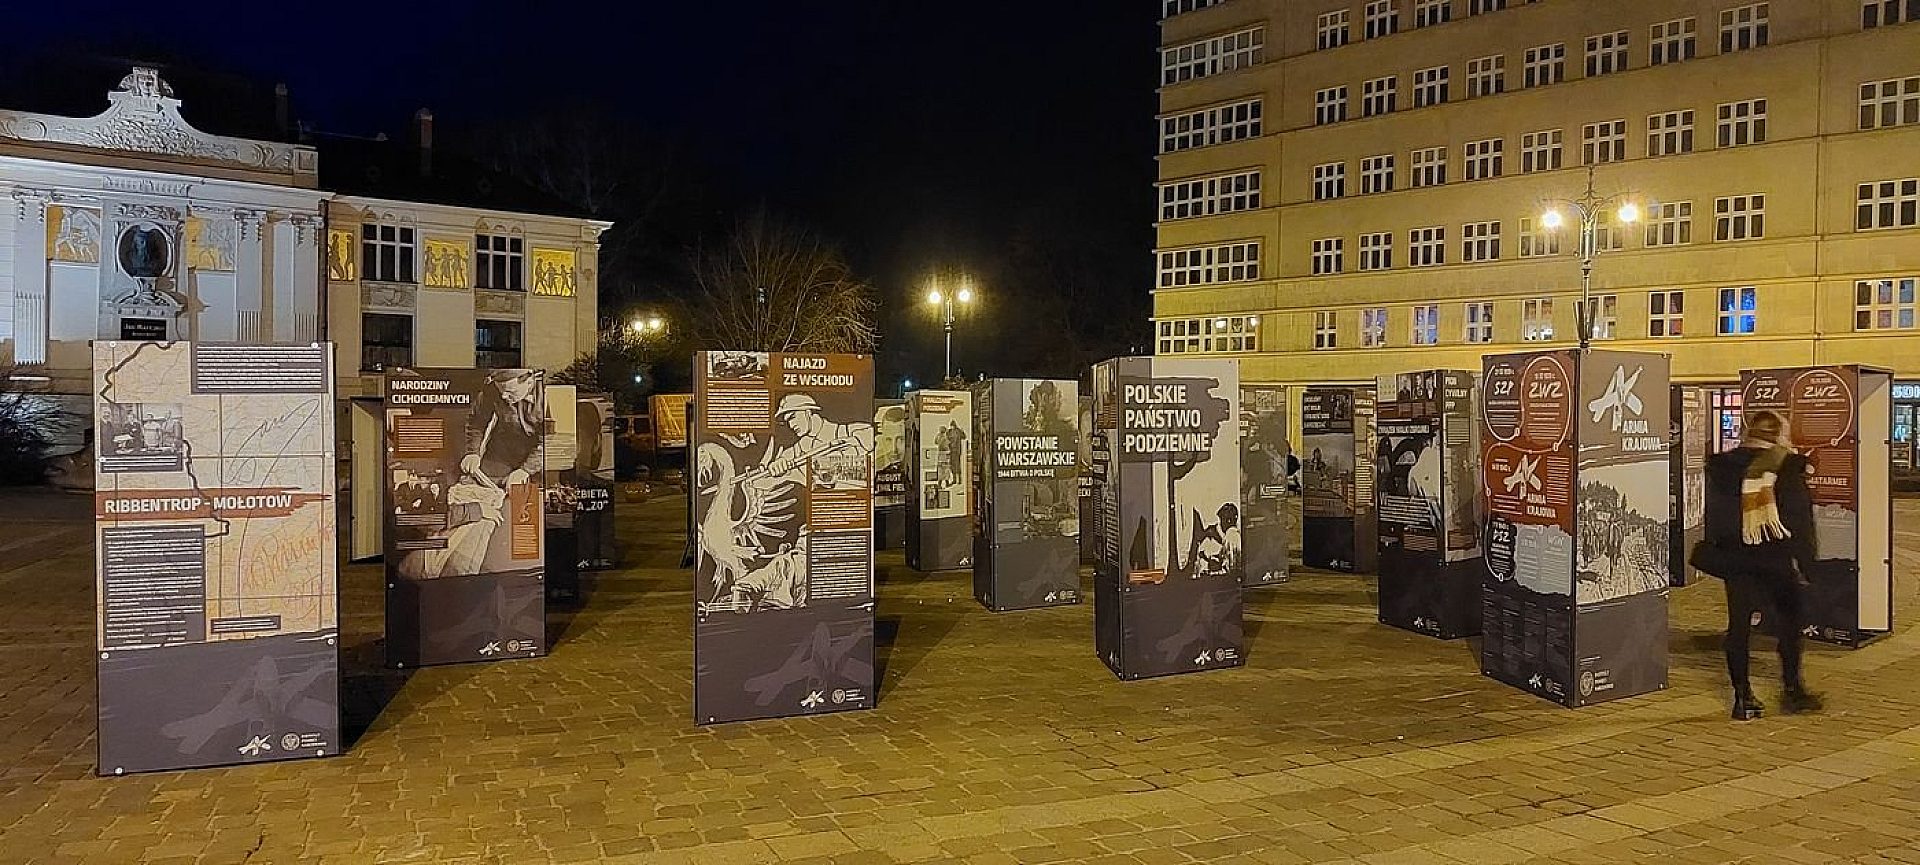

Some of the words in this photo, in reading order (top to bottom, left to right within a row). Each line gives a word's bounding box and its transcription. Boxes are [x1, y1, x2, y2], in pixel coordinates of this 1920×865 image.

[783, 358, 827, 370] NAJAZD
[391, 380, 451, 391] NARODZINY
[783, 374, 798, 386] ZE
[799, 374, 854, 386] WSCHODU
[1125, 384, 1187, 404] POLSKIE
[1529, 381, 1564, 399] ZWZ
[1804, 385, 1842, 398] ZWZ
[391, 394, 471, 404] CICHOCIEMNYCH
[1125, 404, 1202, 429] PAŃSTWO
[1622, 420, 1649, 434] ARMIA
[997, 436, 1058, 451] POWSTANIE
[1125, 433, 1209, 453] PODZIEMNE
[1622, 436, 1662, 451] KRAJOWA
[998, 451, 1075, 467] WARSZAWSKIE
[105, 499, 201, 514] RIBBENTROP
[213, 495, 292, 510] MOŁOTOW
